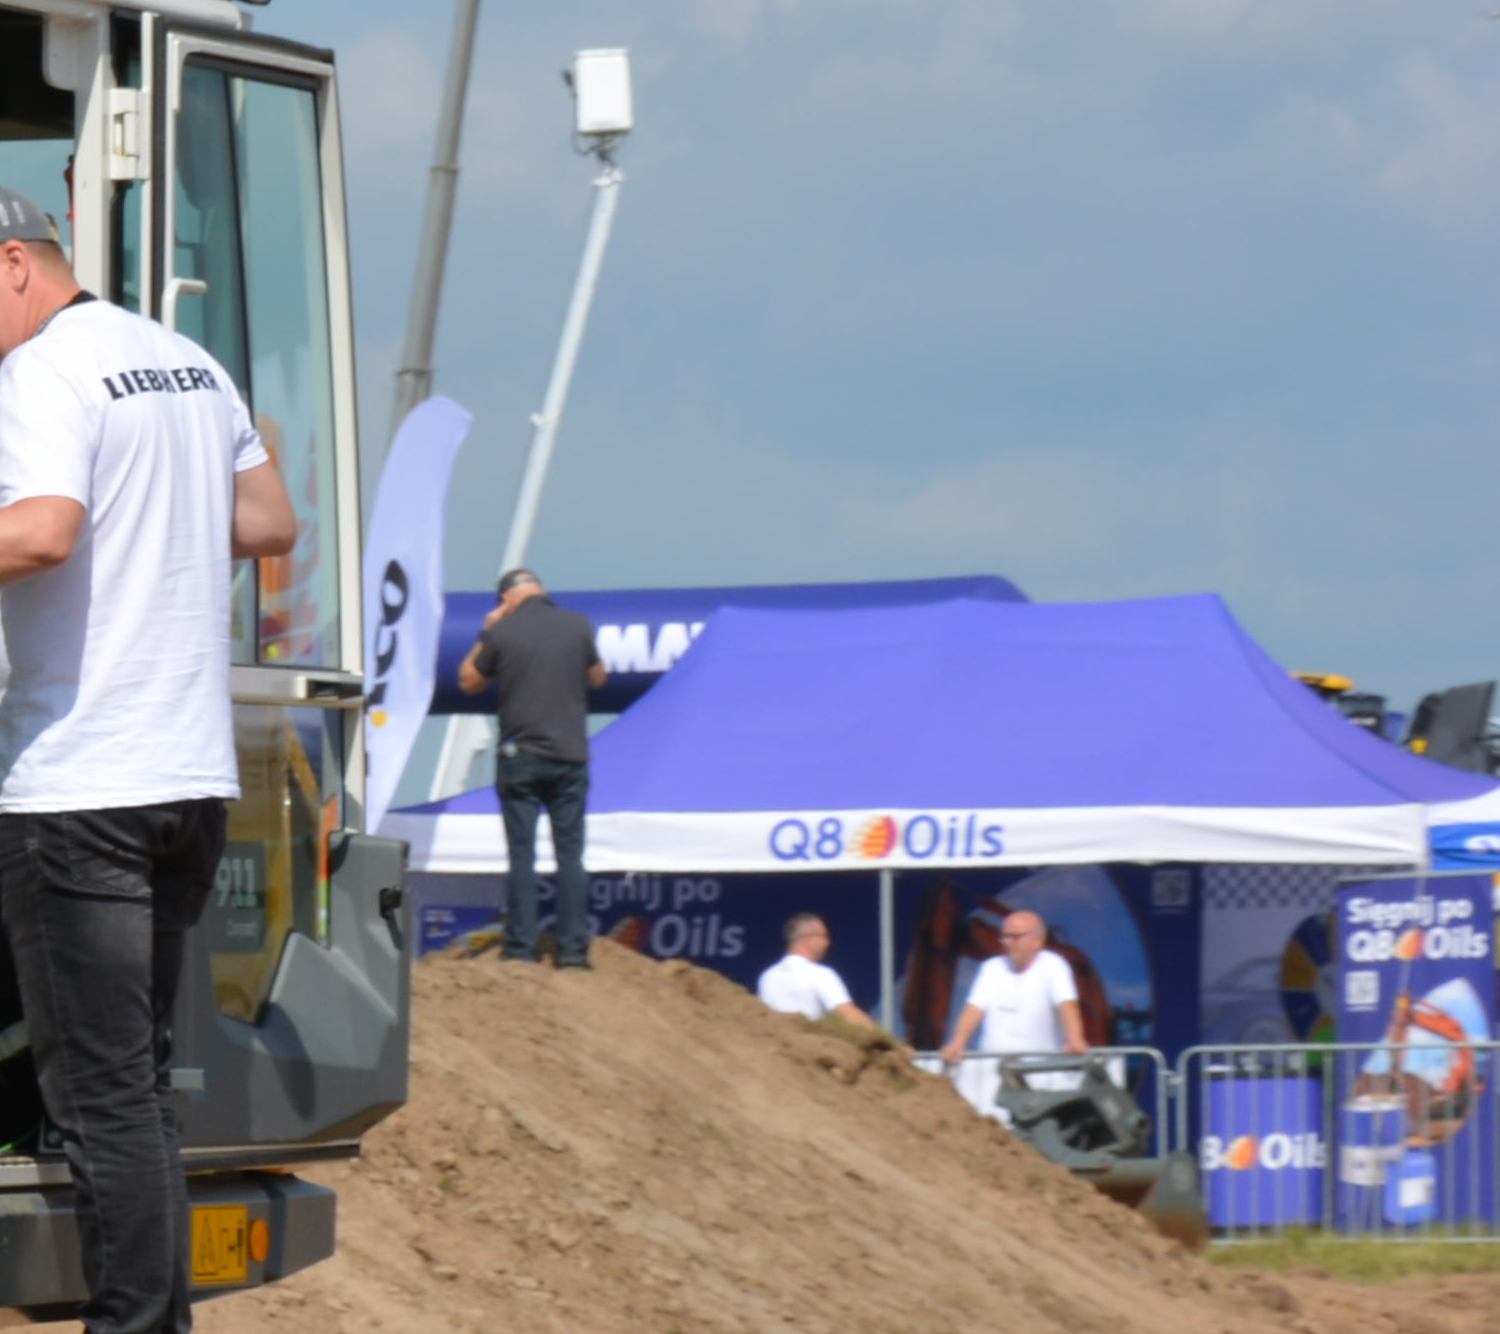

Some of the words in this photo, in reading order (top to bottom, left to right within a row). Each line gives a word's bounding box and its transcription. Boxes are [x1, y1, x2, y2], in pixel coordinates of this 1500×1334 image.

[102, 366, 221, 400] LIEBHERR
[768, 817, 844, 862] Q8
[903, 814, 1004, 859] Oils
[672, 877, 721, 911] po
[1437, 898, 1474, 925] po
[651, 913, 746, 958] Oils
[1346, 930, 1395, 962] Q8
[1425, 925, 1489, 960] Oils
